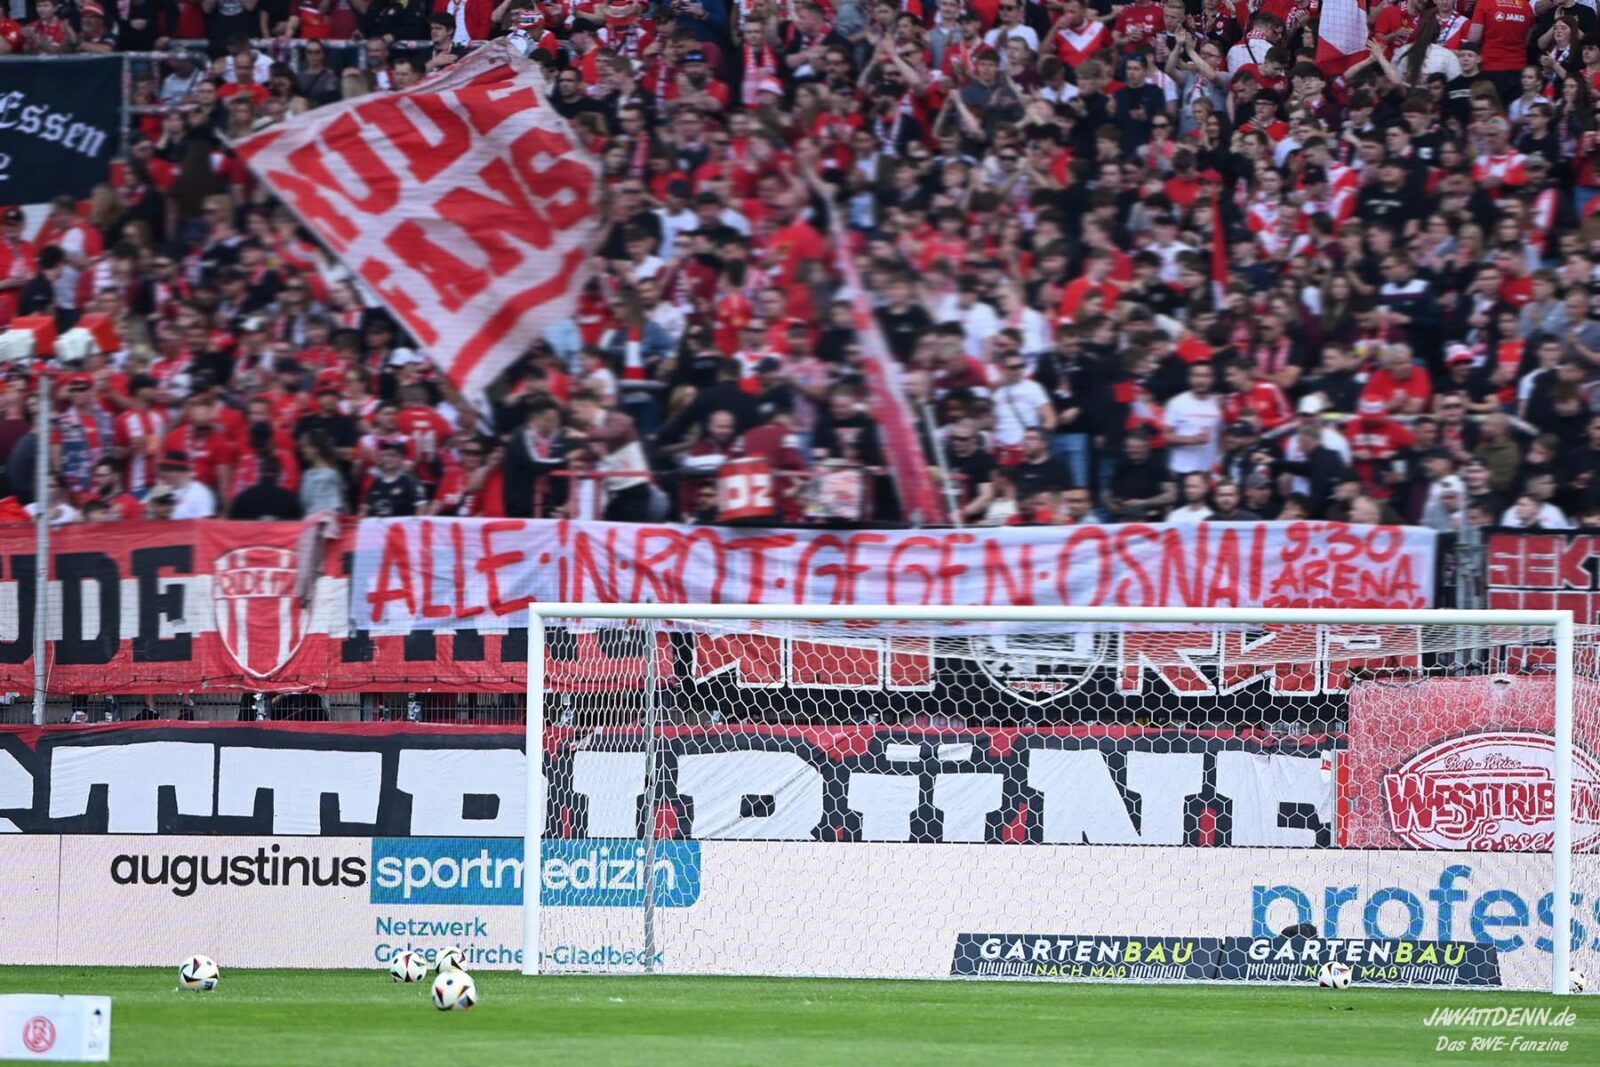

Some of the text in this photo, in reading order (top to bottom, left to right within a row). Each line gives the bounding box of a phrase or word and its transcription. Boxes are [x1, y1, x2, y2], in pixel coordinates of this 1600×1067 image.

[367, 520, 537, 622] ALLE
[793, 532, 1034, 627] GEGEN
[1270, 554, 1421, 599] ARENA
[1488, 535, 1600, 589] SEK
[111, 844, 366, 897] augustinus
[376, 917, 487, 937] Netzwerk
[979, 938, 1193, 963] GARTENBAU
[1248, 939, 1466, 966] GARTENBAU
[1035, 964, 1083, 977] NACH
